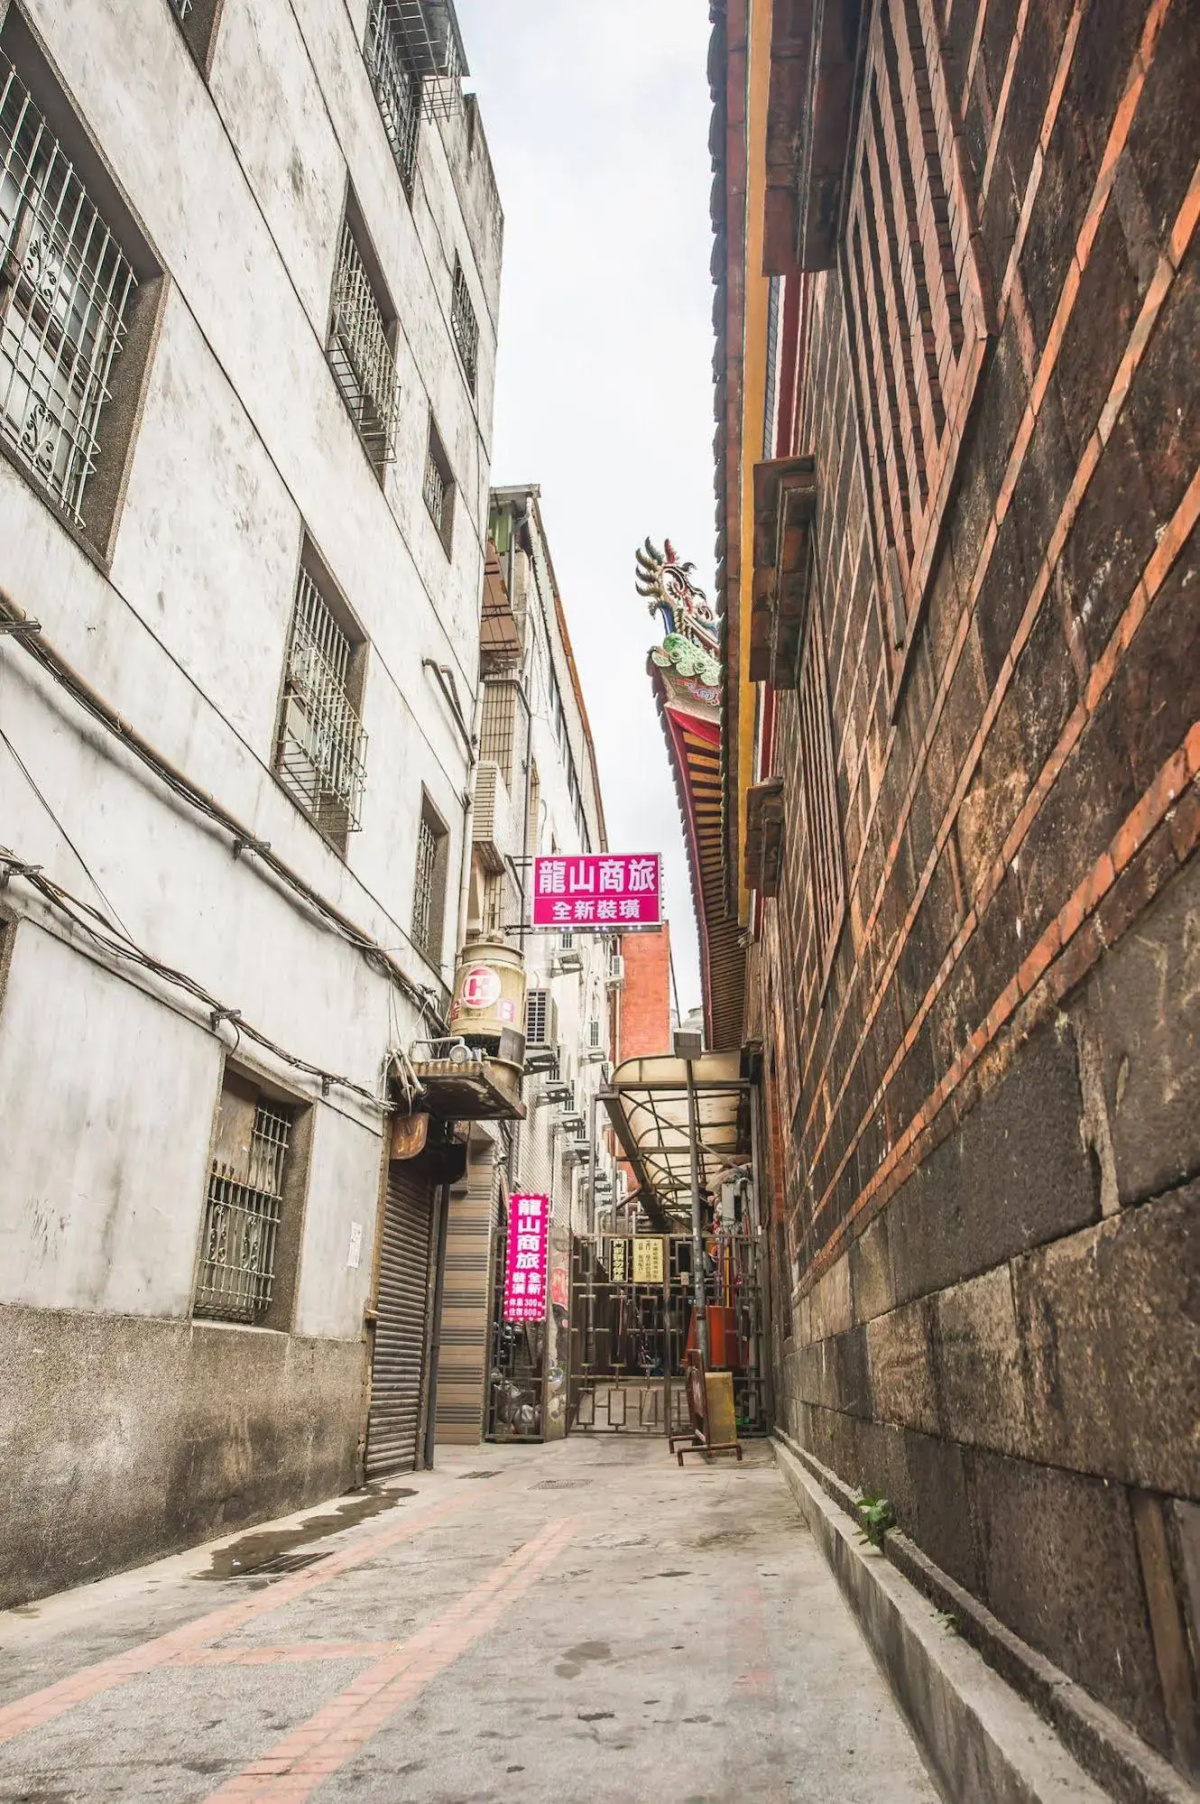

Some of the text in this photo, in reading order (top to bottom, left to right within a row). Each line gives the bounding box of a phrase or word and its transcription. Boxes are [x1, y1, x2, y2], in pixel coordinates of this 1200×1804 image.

[539, 859, 655, 893] 龍山商旅
[516, 1199, 542, 1269] 龍山商旅
